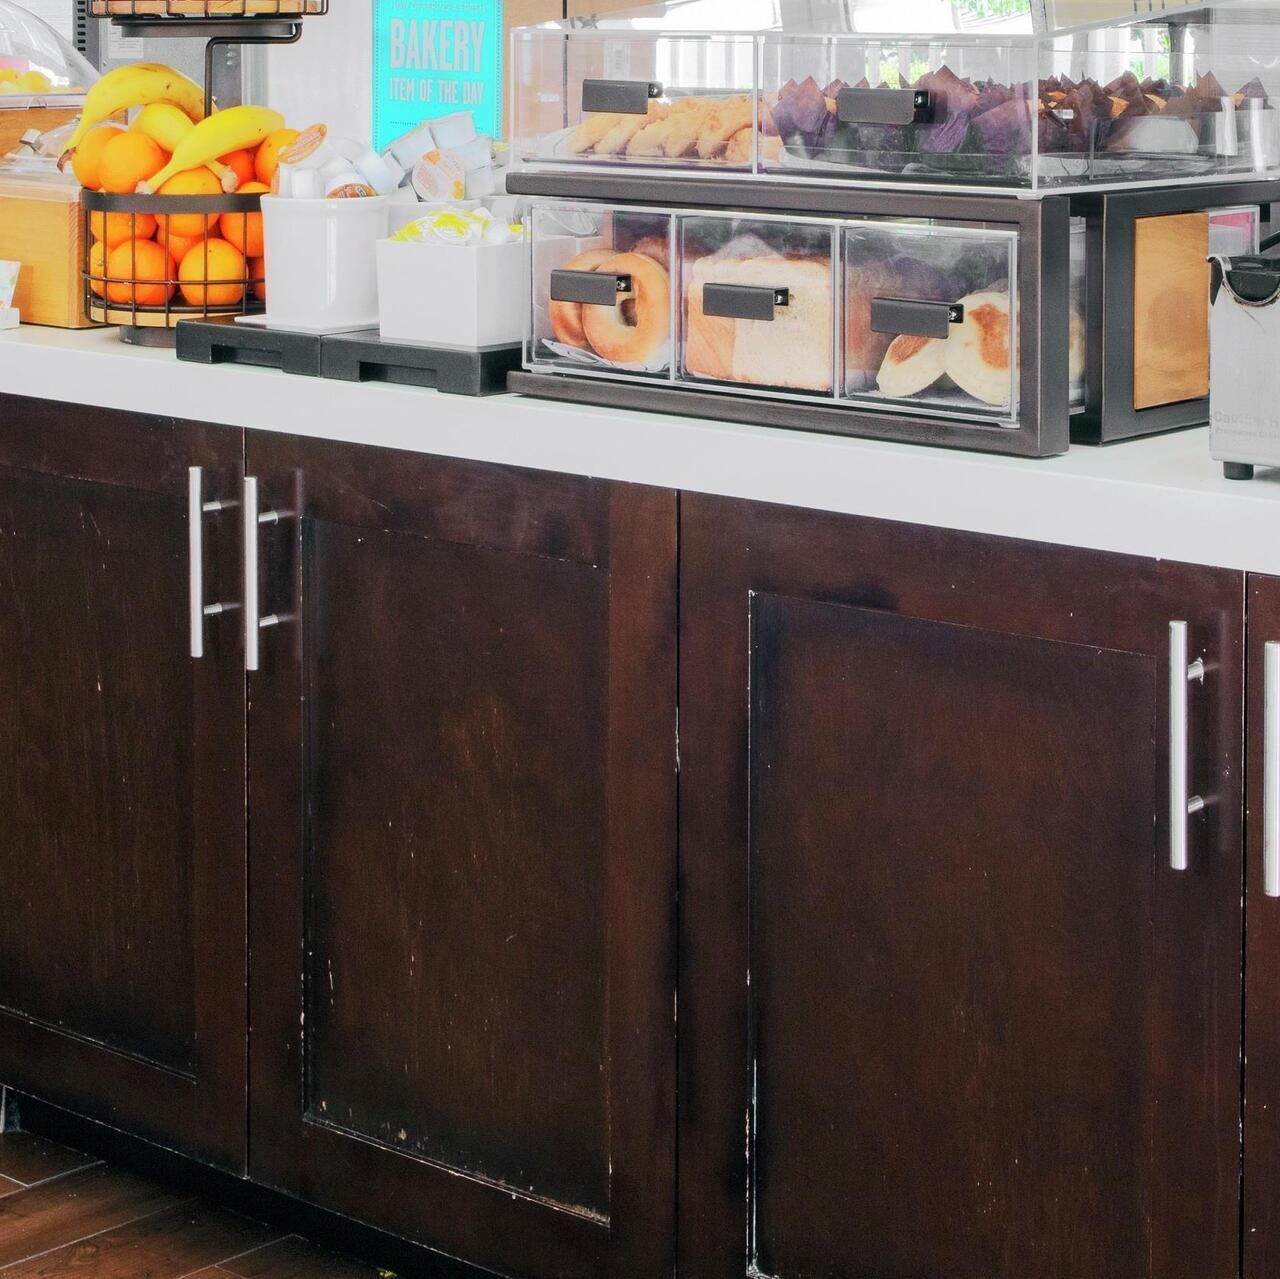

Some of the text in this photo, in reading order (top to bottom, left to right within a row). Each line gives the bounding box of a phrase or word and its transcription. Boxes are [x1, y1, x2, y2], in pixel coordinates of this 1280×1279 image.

[390, 19, 484, 72] BAKERY
[389, 77, 484, 105] ITEM OF THE DAY
